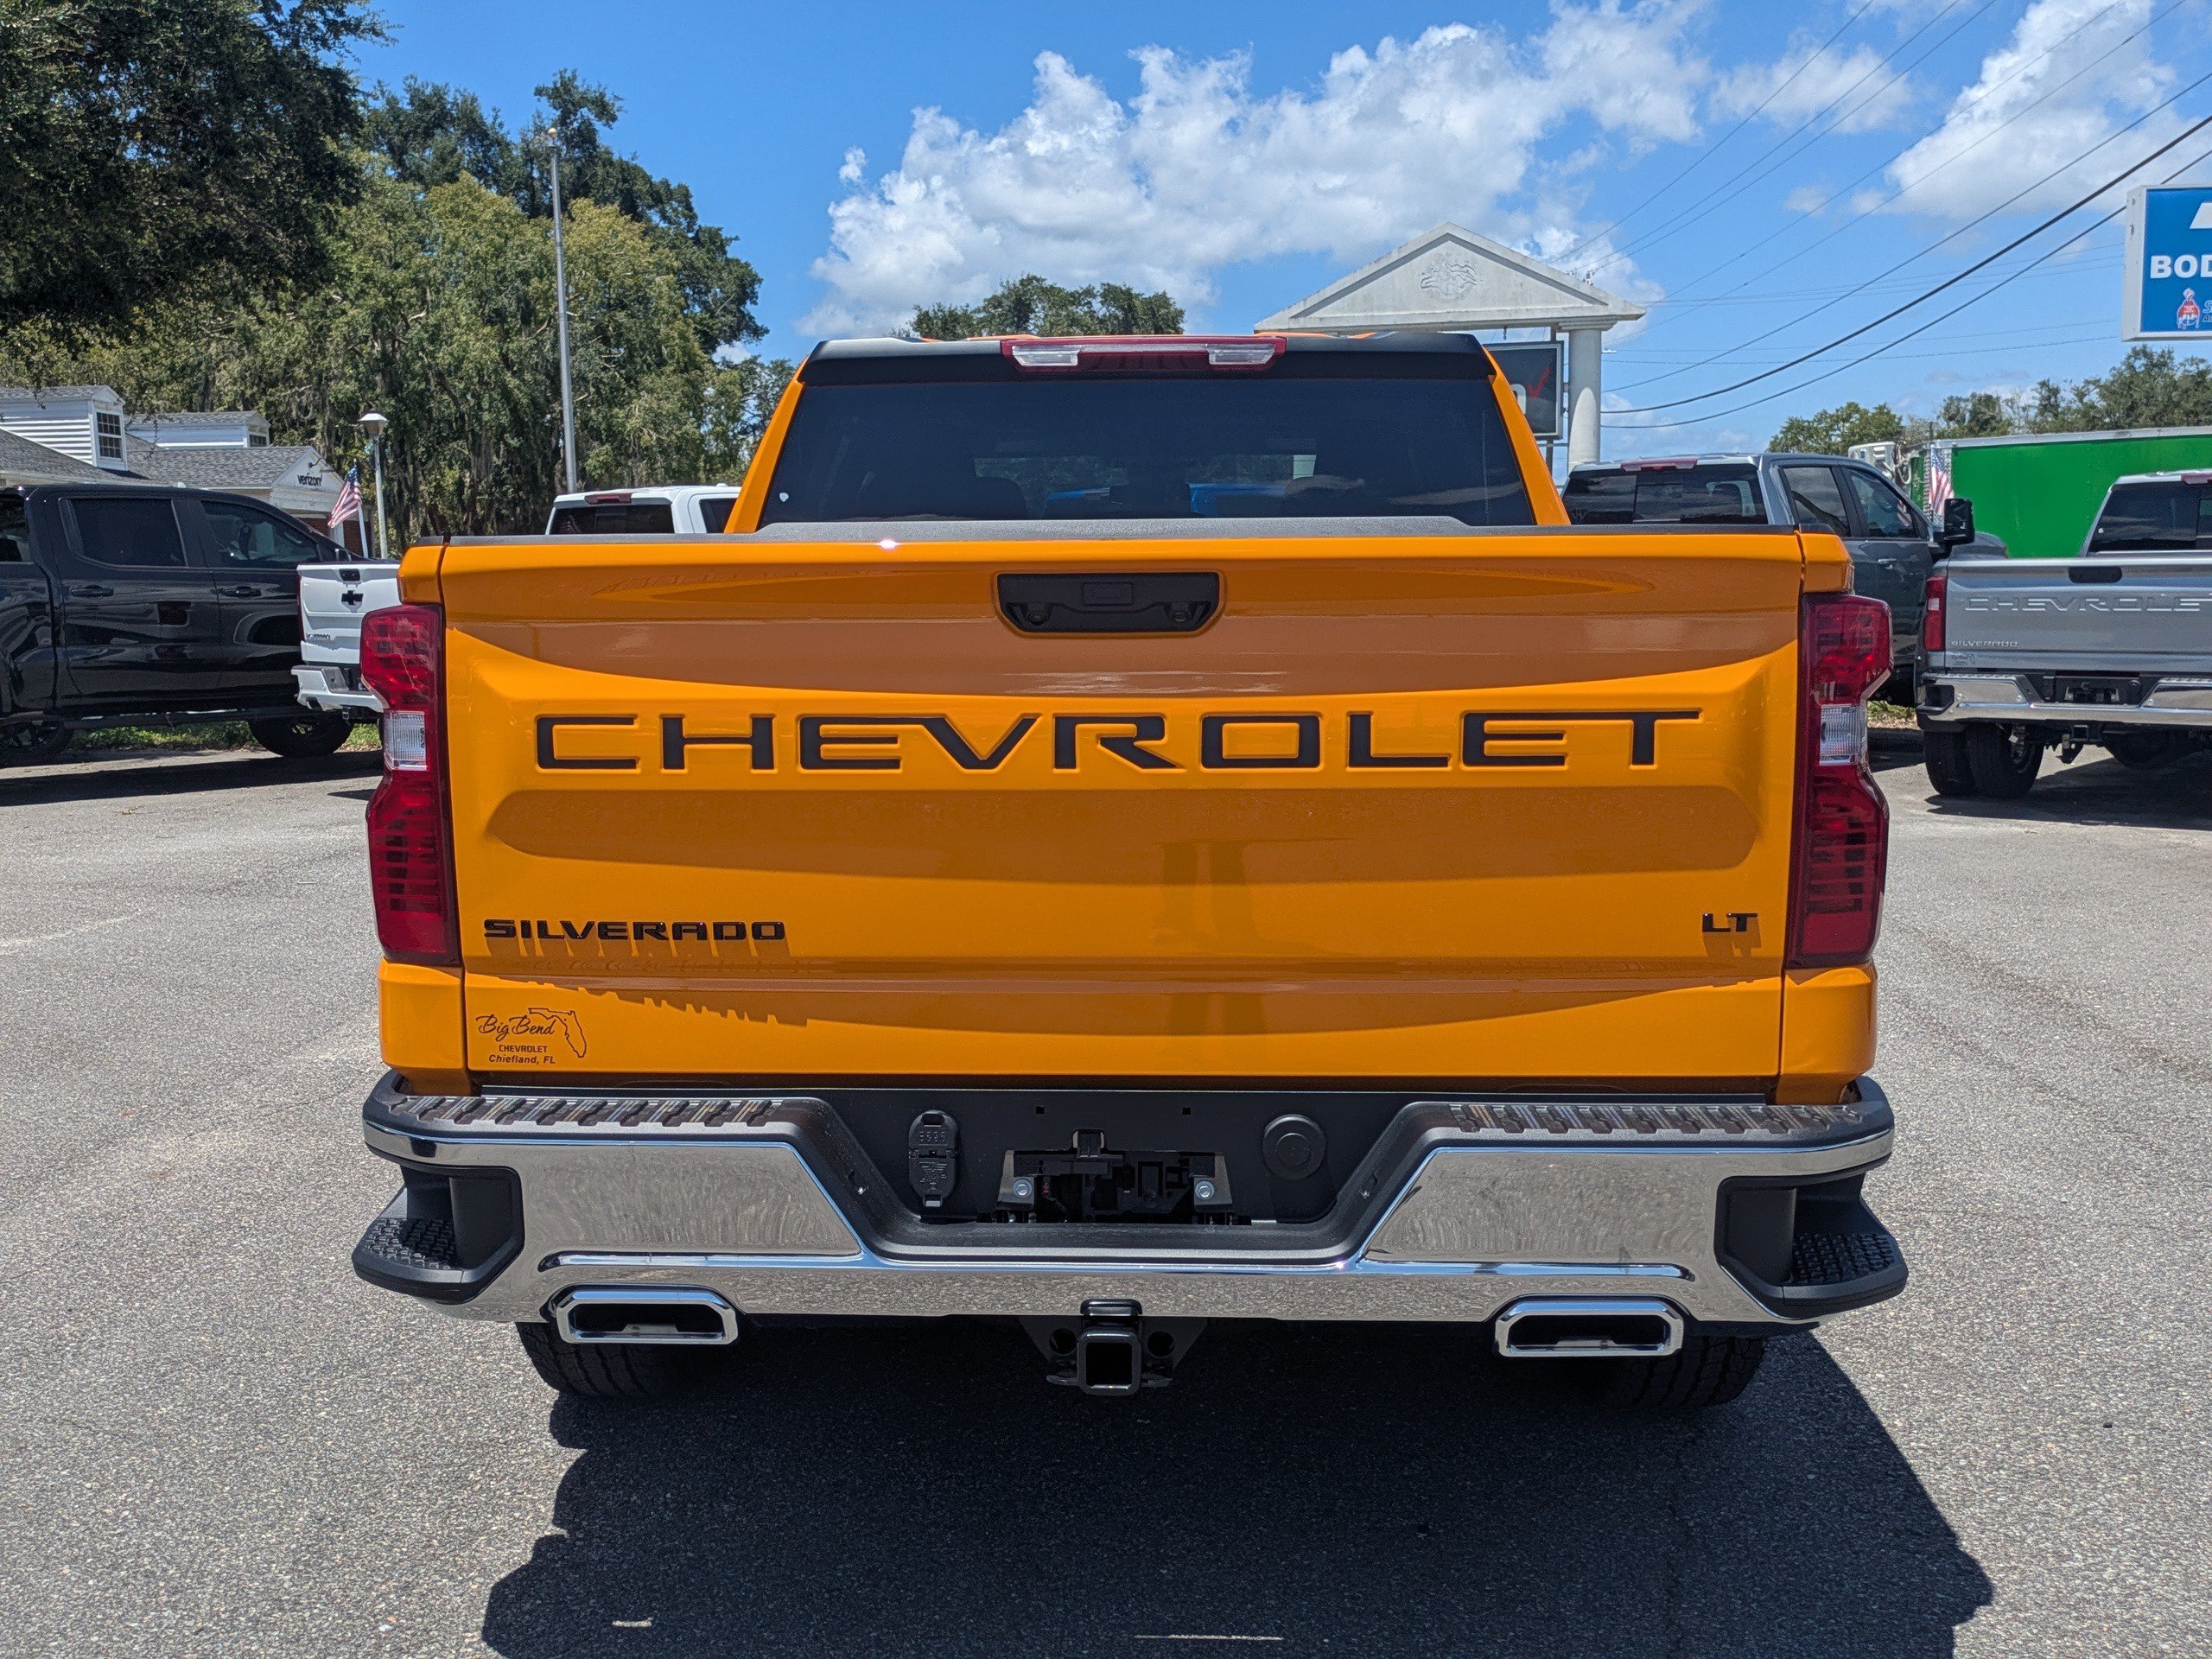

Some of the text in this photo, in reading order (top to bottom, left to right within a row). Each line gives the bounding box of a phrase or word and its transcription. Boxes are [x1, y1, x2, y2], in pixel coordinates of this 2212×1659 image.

[297, 473, 322, 486] verizon
[535, 709, 1704, 772] CHEVROLET
[484, 918, 786, 941] SILVERADO
[1701, 912, 1758, 933] LT
[475, 1014, 556, 1042] Big Bend
[488, 1054, 556, 1065] Chiefland, FL
[499, 1045, 548, 1053] CHEVROLET
